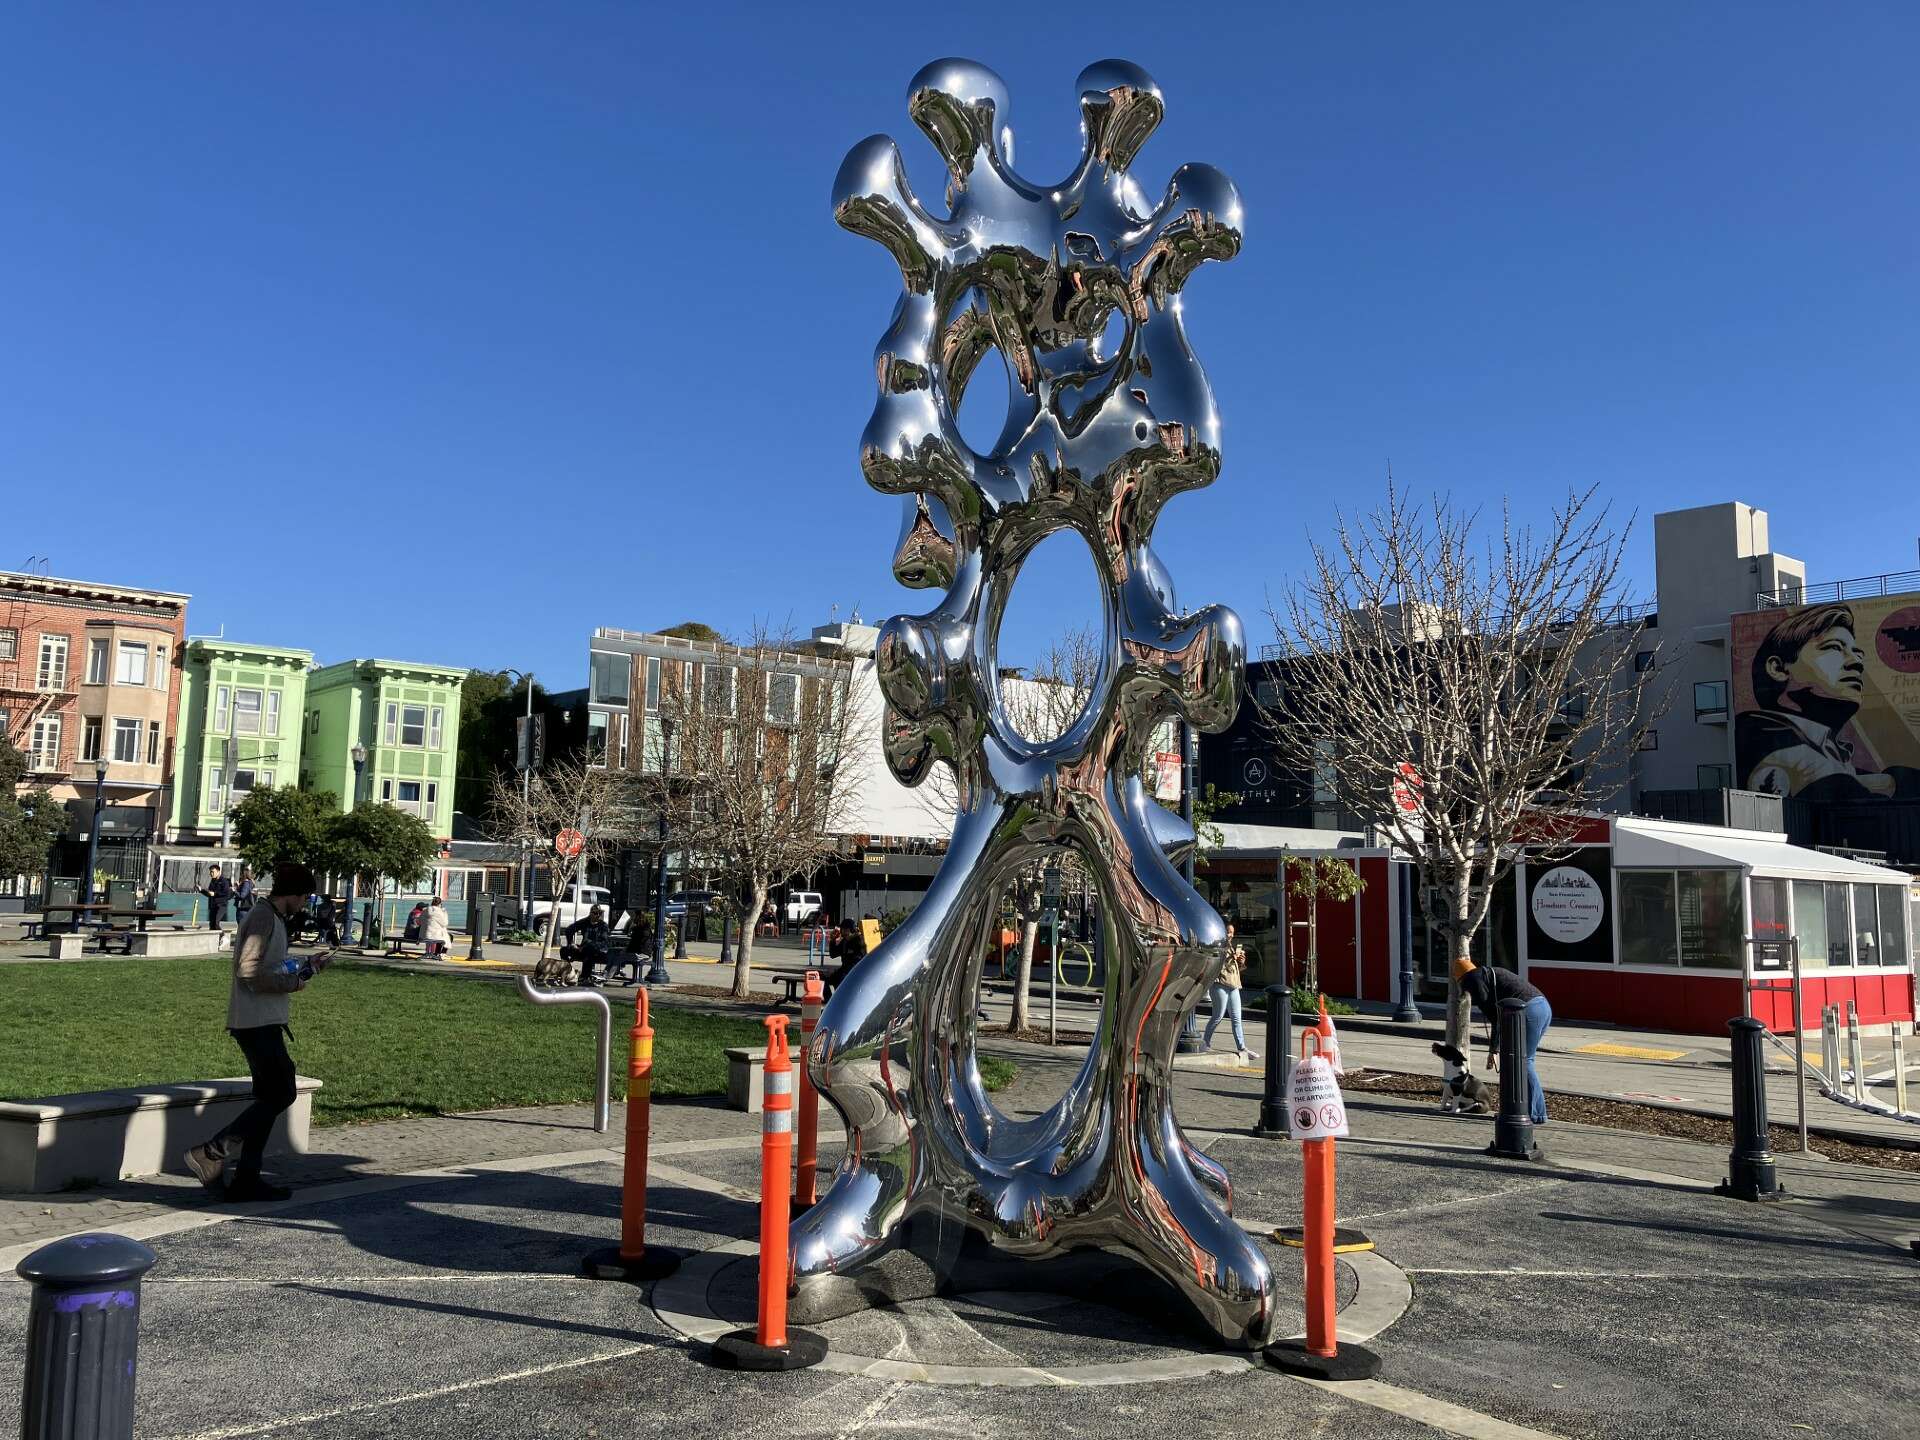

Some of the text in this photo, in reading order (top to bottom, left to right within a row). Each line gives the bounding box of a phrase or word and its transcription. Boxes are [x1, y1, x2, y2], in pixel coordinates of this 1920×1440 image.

[558, 837, 581, 849] SOP
[1295, 1067, 1318, 1075] PLEASE
[1295, 1077, 1308, 1085] NOT
[1294, 1093, 1335, 1103] THE ARTWORK
